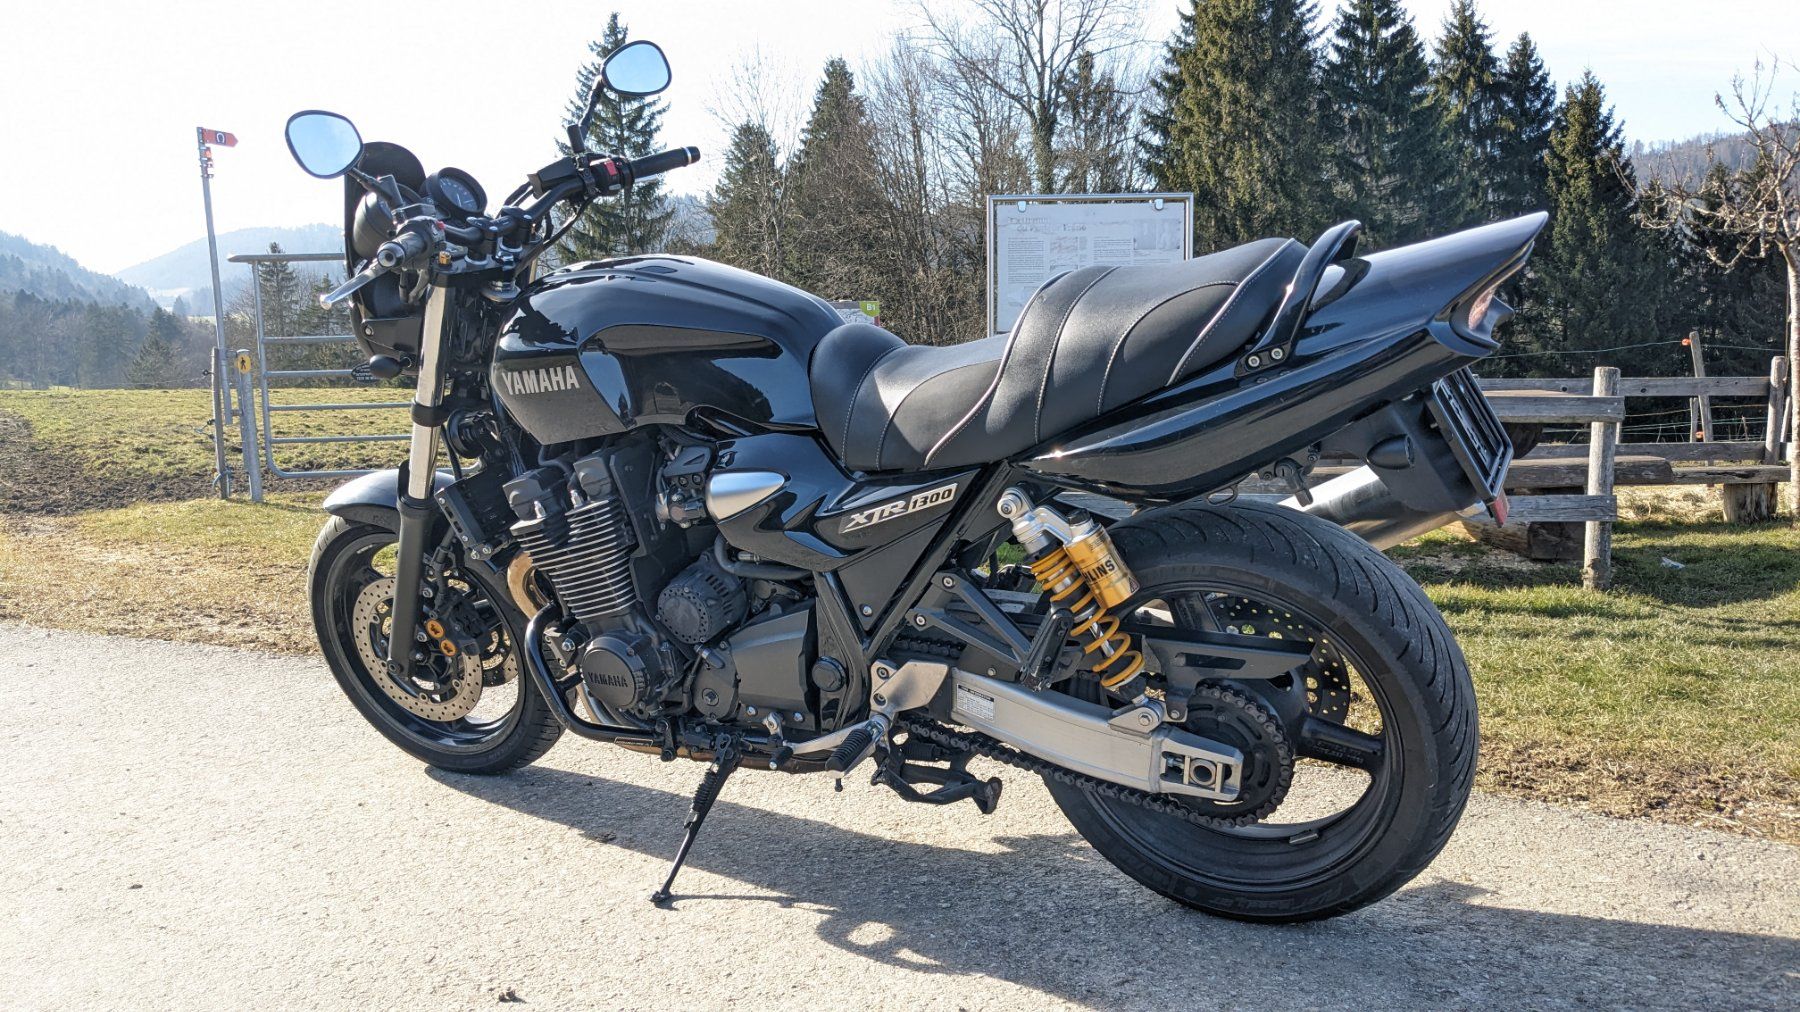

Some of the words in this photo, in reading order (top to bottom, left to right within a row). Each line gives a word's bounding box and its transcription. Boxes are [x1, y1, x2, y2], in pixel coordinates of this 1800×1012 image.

[502, 365, 580, 396] YAMAHA
[844, 500, 907, 529] XJR
[911, 488, 953, 510] 1300
[588, 671, 629, 688] YAMAHA
